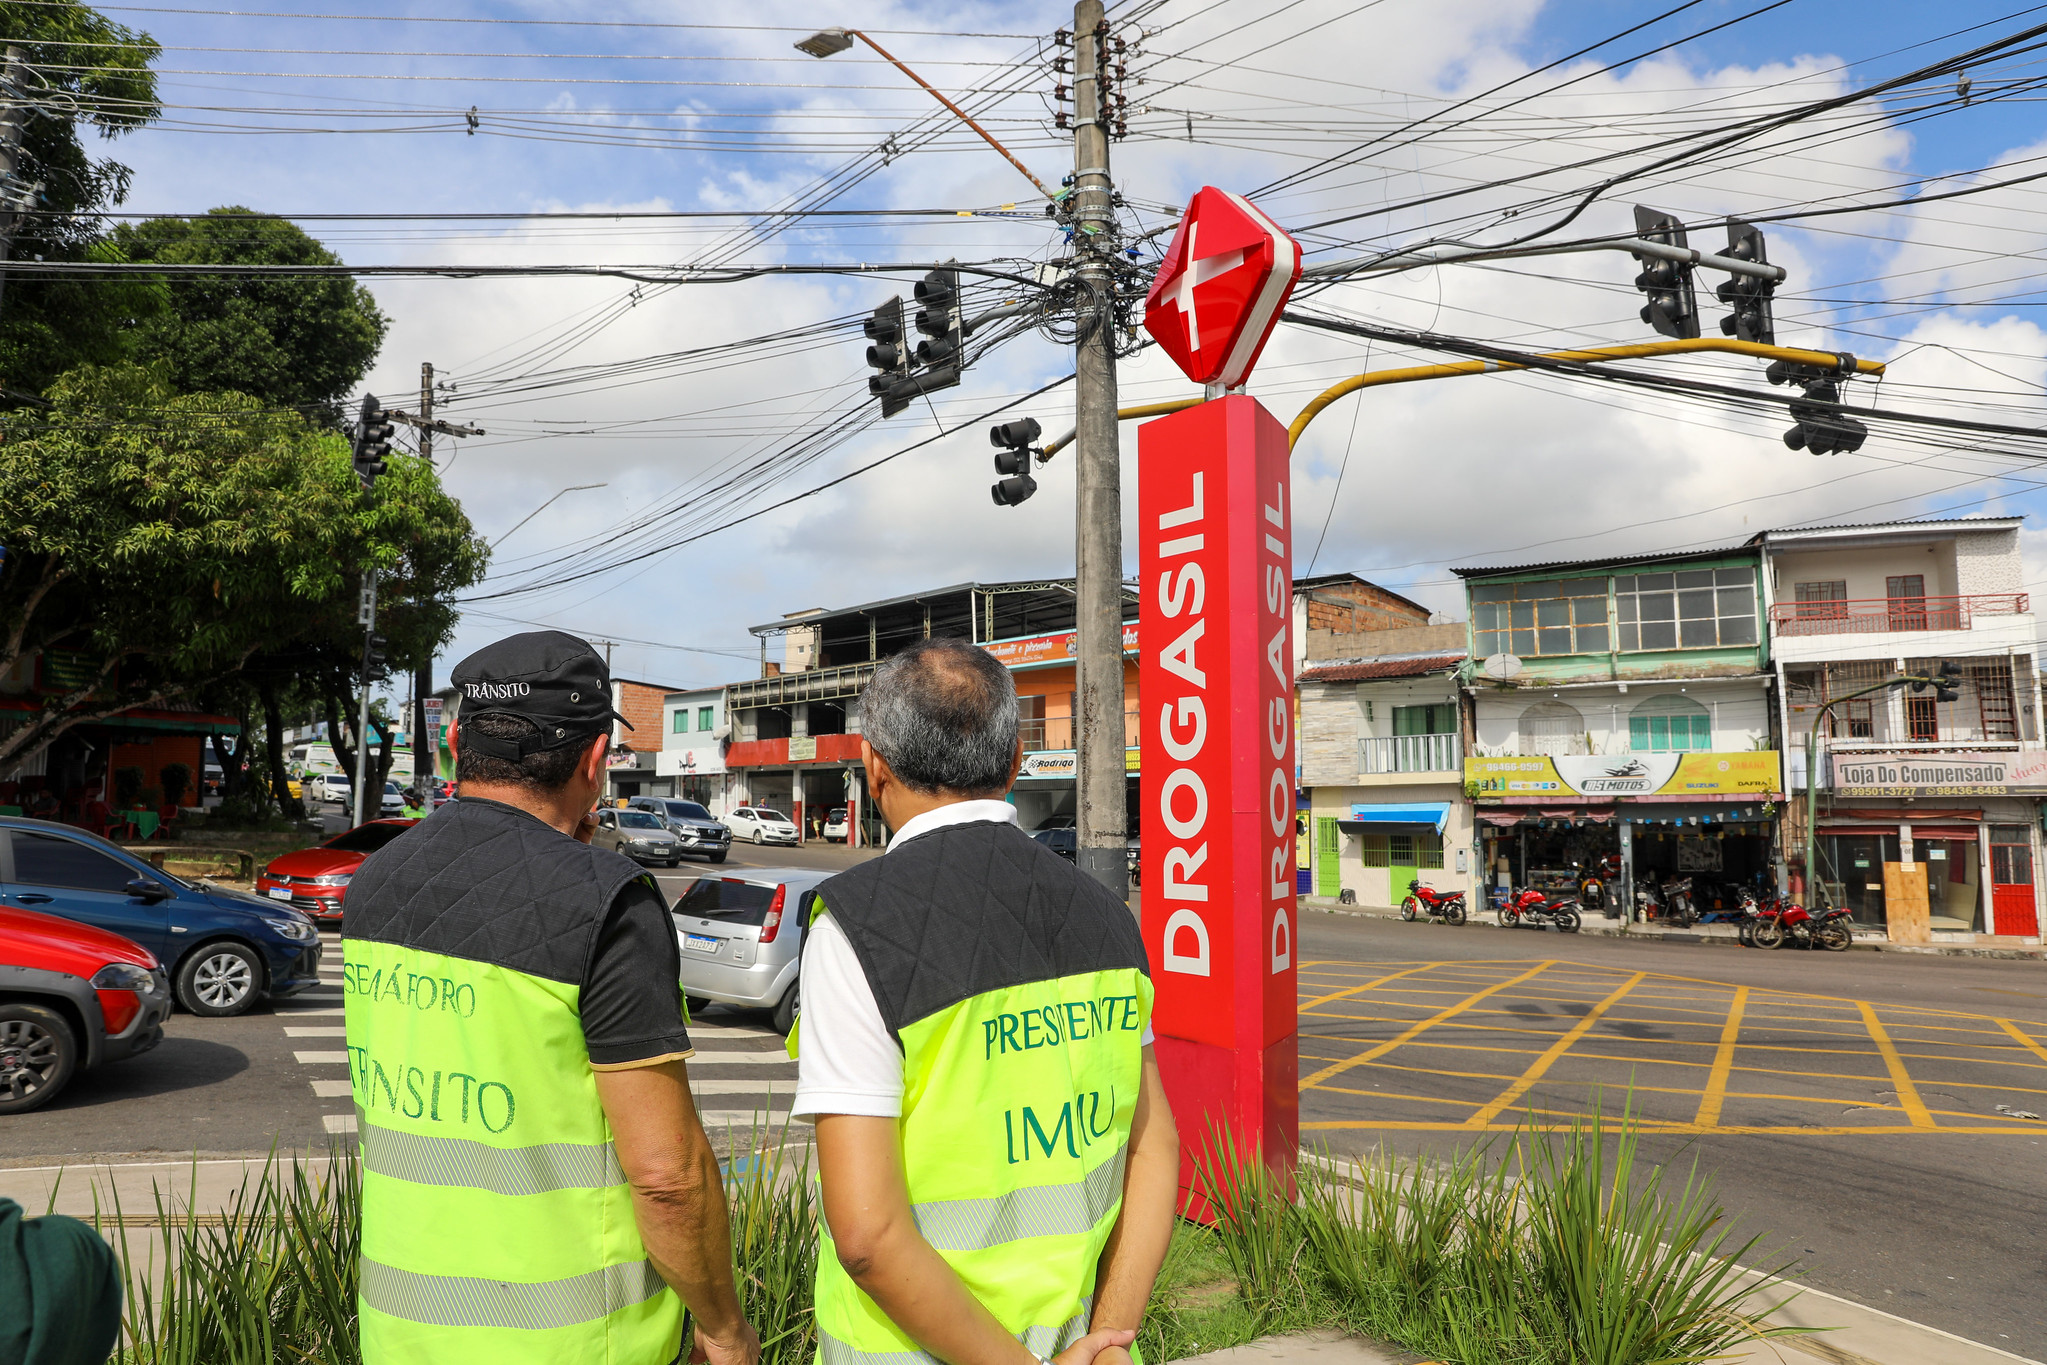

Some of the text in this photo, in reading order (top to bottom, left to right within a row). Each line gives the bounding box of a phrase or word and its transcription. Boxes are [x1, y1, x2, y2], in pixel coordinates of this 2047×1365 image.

[465, 682, 531, 699] TRÂNSITO
[1159, 471, 1210, 977] DROGASIL
[1265, 482, 1291, 975] DROGASIL
[1037, 759, 1074, 768] Rodrigo
[1731, 761, 1766, 770] YAMAHA
[1844, 765, 2004, 784] Loja Do Compensado
[1607, 781, 1645, 790] MOTOS
[1936, 786, 2007, 795] 98436-6483
[1851, 786, 1917, 796] 99501-3727
